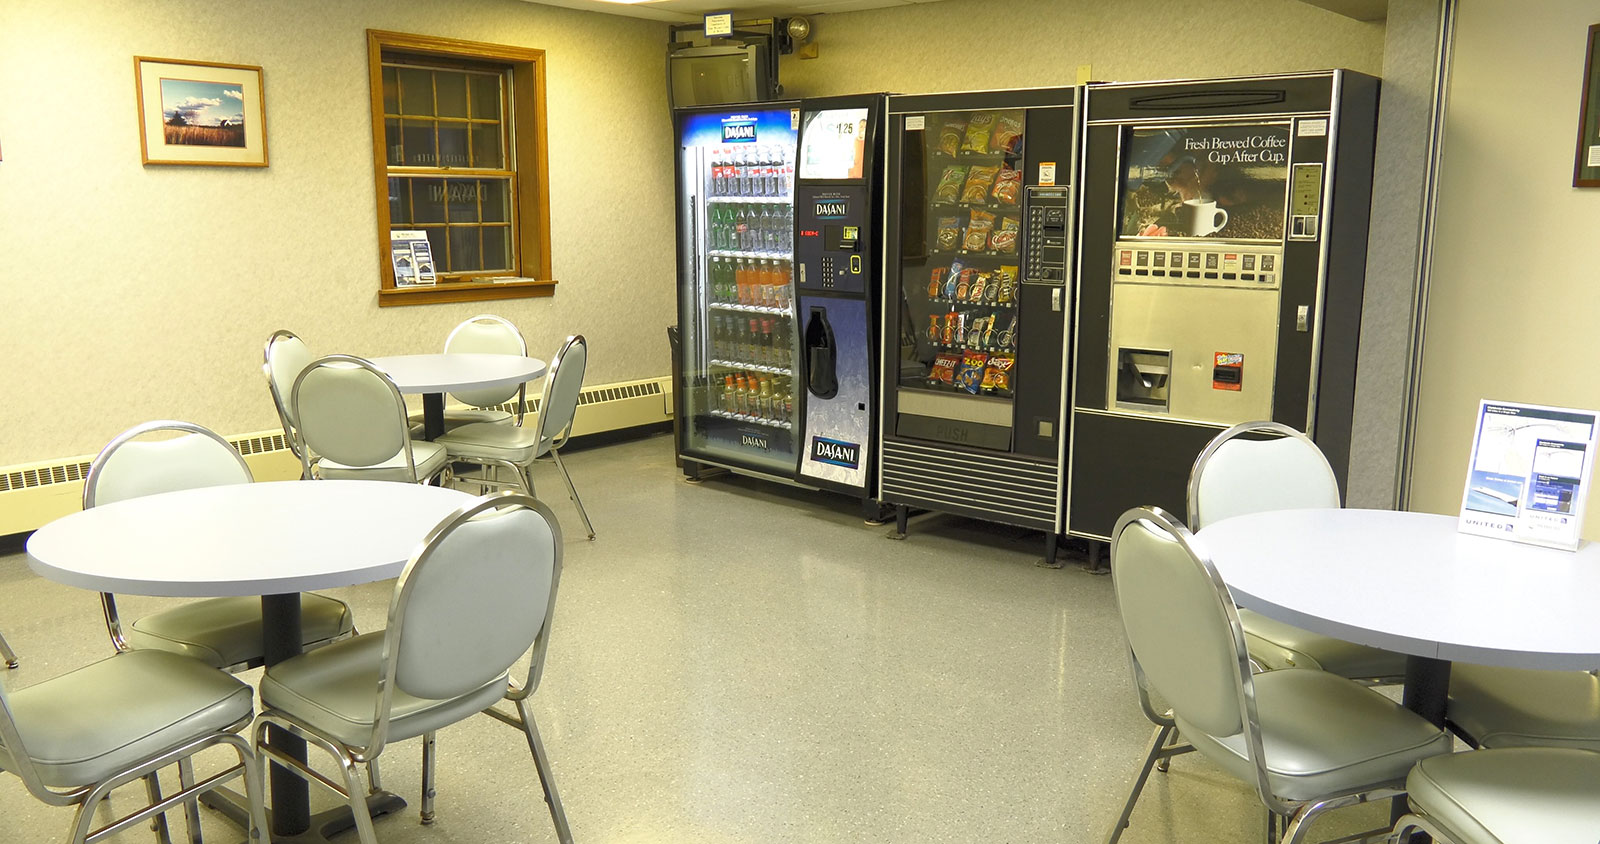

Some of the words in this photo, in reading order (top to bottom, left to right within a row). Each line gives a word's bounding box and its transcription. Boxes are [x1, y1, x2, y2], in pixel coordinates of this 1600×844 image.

[725, 125, 754, 139] DASANI
[1185, 138, 1210, 151] Fresh
[1212, 136, 1250, 150] Brewed
[1250, 135, 1286, 148] Coffee
[1208, 150, 1231, 165] Cup
[1231, 149, 1259, 163] After
[1259, 149, 1285, 164] Cup.
[816, 203, 846, 216] DASANI
[963, 357, 984, 368] ZOO
[936, 424, 969, 442] PUSH
[742, 435, 767, 448] DASANI
[817, 441, 855, 462] DASANI
[1465, 519, 1503, 530] UNITED
